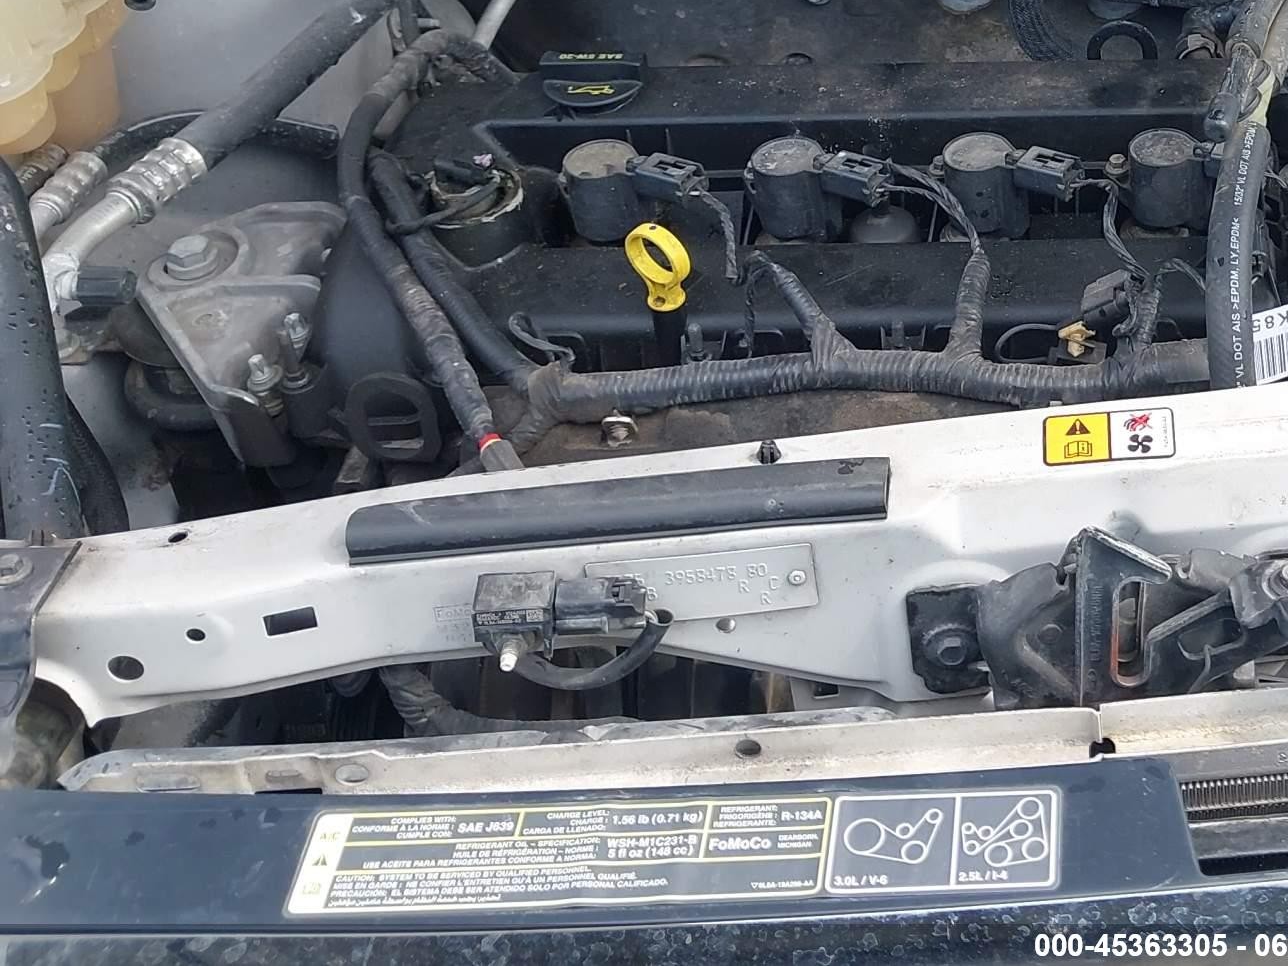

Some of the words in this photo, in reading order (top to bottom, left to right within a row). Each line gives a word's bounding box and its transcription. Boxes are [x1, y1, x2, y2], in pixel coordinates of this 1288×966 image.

[1238, 160, 1249, 175] DOT
[1231, 313, 1242, 332] AIS
[1233, 336, 1243, 360] DOT
[1235, 363, 1244, 379] VL
[547, 812, 581, 821] CHARGE
[582, 809, 610, 818] LEVEL:
[720, 804, 778, 813] REFRIGERANT:
[391, 816, 433, 825] COMPLIES
[434, 815, 456, 823] WITH:
[570, 817, 604, 826] CHARGE
[612, 814, 637, 825] 1.56
[638, 814, 650, 825] lb
[651, 813, 680, 825] (0.71
[682, 810, 704, 824] kg)
[781, 810, 823, 822] R-134A
[352, 825, 398, 833] CONFORME
[420, 822, 450, 831] NORME
[457, 822, 484, 833] SAE
[523, 826, 552, 835] CARGA
[566, 824, 607, 833] LLENADO:
[713, 819, 777, 828] REFRIGERANTE:
[396, 831, 431, 839] CUMPLE
[432, 830, 452, 838] CON:
[455, 841, 513, 850] REFRIGERANT
[538, 837, 601, 848] SPECIFICATION:
[606, 834, 698, 849] WSH-M1C231-B
[708, 835, 773, 852] FoMoCo
[452, 850, 477, 859] HUILE
[565, 846, 595, 855] NORME
[607, 848, 617, 858] 5
[618, 848, 628, 857] fl
[628, 849, 643, 858] oz
[645, 847, 672, 859] (148
[672, 845, 695, 856] cc)
[362, 861, 381, 870] USE
[381, 859, 411, 868] ACEITE
[412, 858, 436, 867] PARA
[436, 857, 506, 867] REFRIGERANTES
[507, 855, 555, 865] CONFORME
[564, 852, 597, 862] NORMA:
[335, 873, 376, 883] CAUTION:
[379, 873, 413, 882] SYSTEM
[495, 869, 540, 878] QUALIFIED
[540, 865, 593, 876] PERSONNEL.
[833, 875, 860, 886] 3.0L
[868, 874, 889, 885] V-6
[958, 871, 983, 882] 2.5L
[991, 870, 1009, 881] I-4
[332, 882, 354, 891] MISE
[368, 881, 398, 890] GARDE
[405, 880, 419, 889] NE
[419, 879, 456, 889] CONFIER
[546, 872, 596, 883] PERSONNEL
[403, 887, 440, 896] SISTEMA
[440, 886, 464, 895] DEBE
[465, 886, 483, 894] SER
[484, 884, 526, 893] ATENDIDO
[551, 882, 570, 891] POR
[570, 880, 616, 890] PERSONAL
